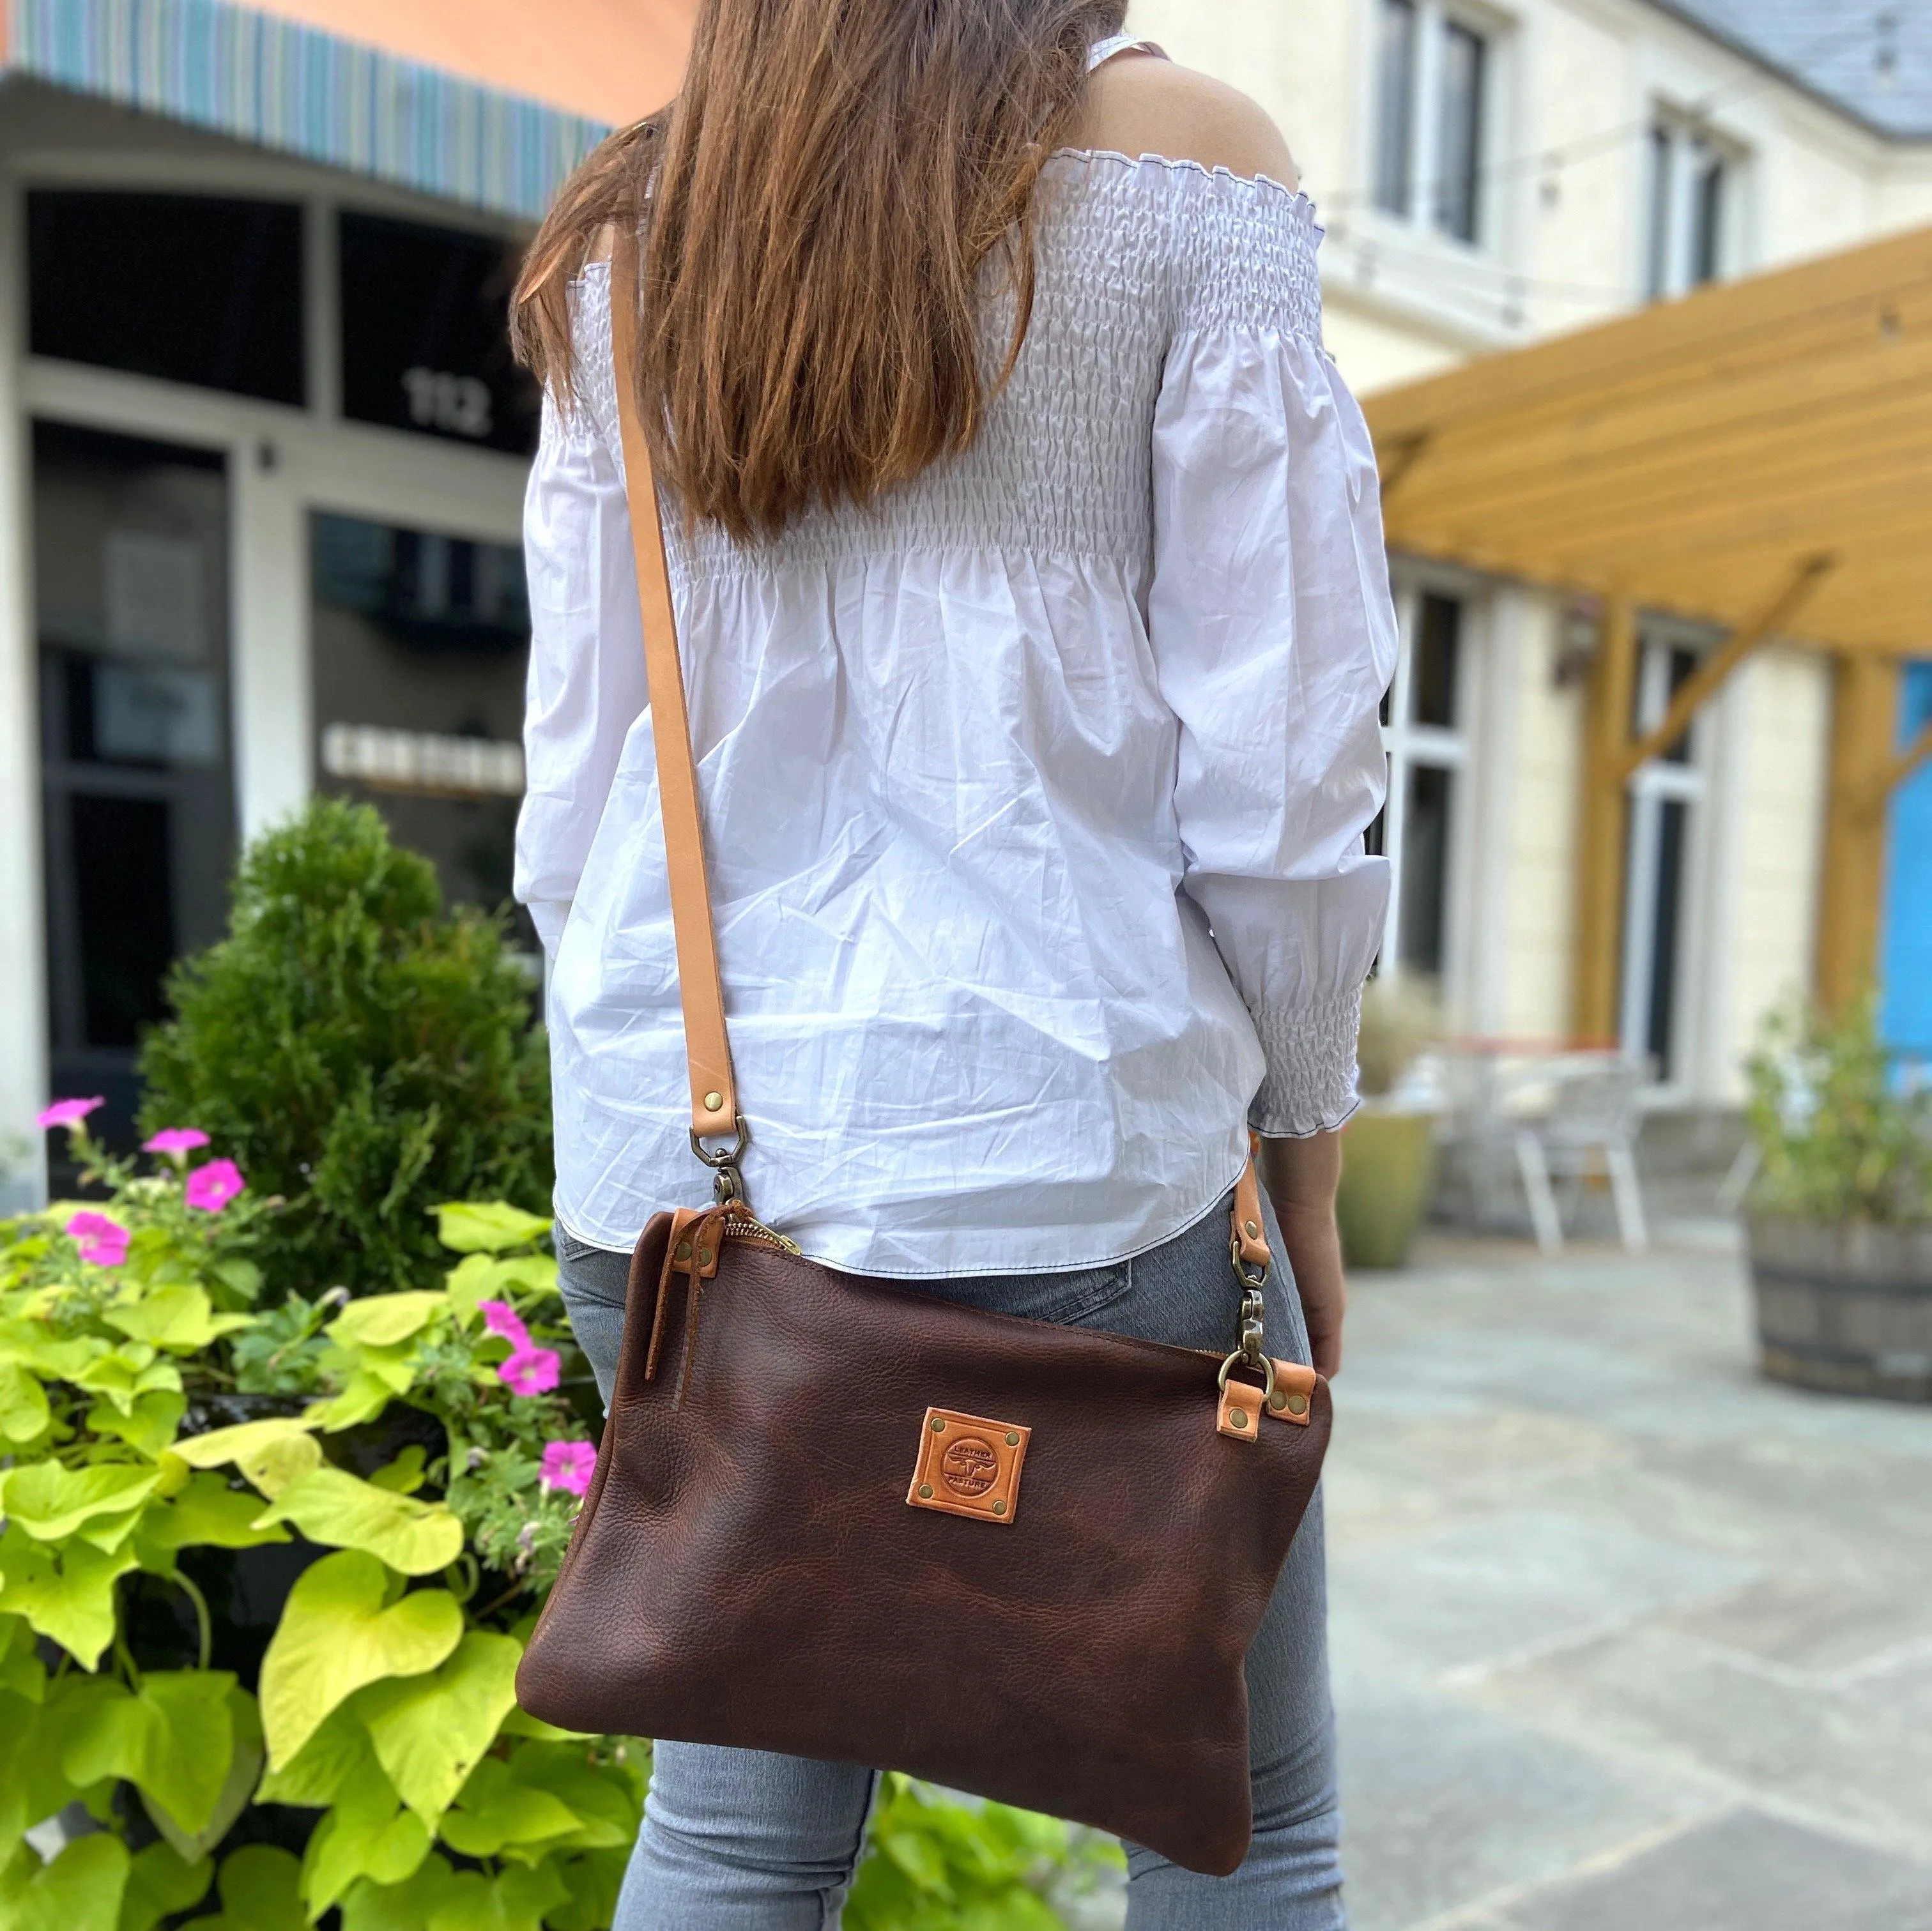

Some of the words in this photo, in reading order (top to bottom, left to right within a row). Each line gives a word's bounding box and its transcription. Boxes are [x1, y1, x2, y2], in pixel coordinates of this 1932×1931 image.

[402, 367, 491, 437] 112
[954, 1446, 992, 1459] LEATHER
[948, 1476, 986, 1488] PASTURE
